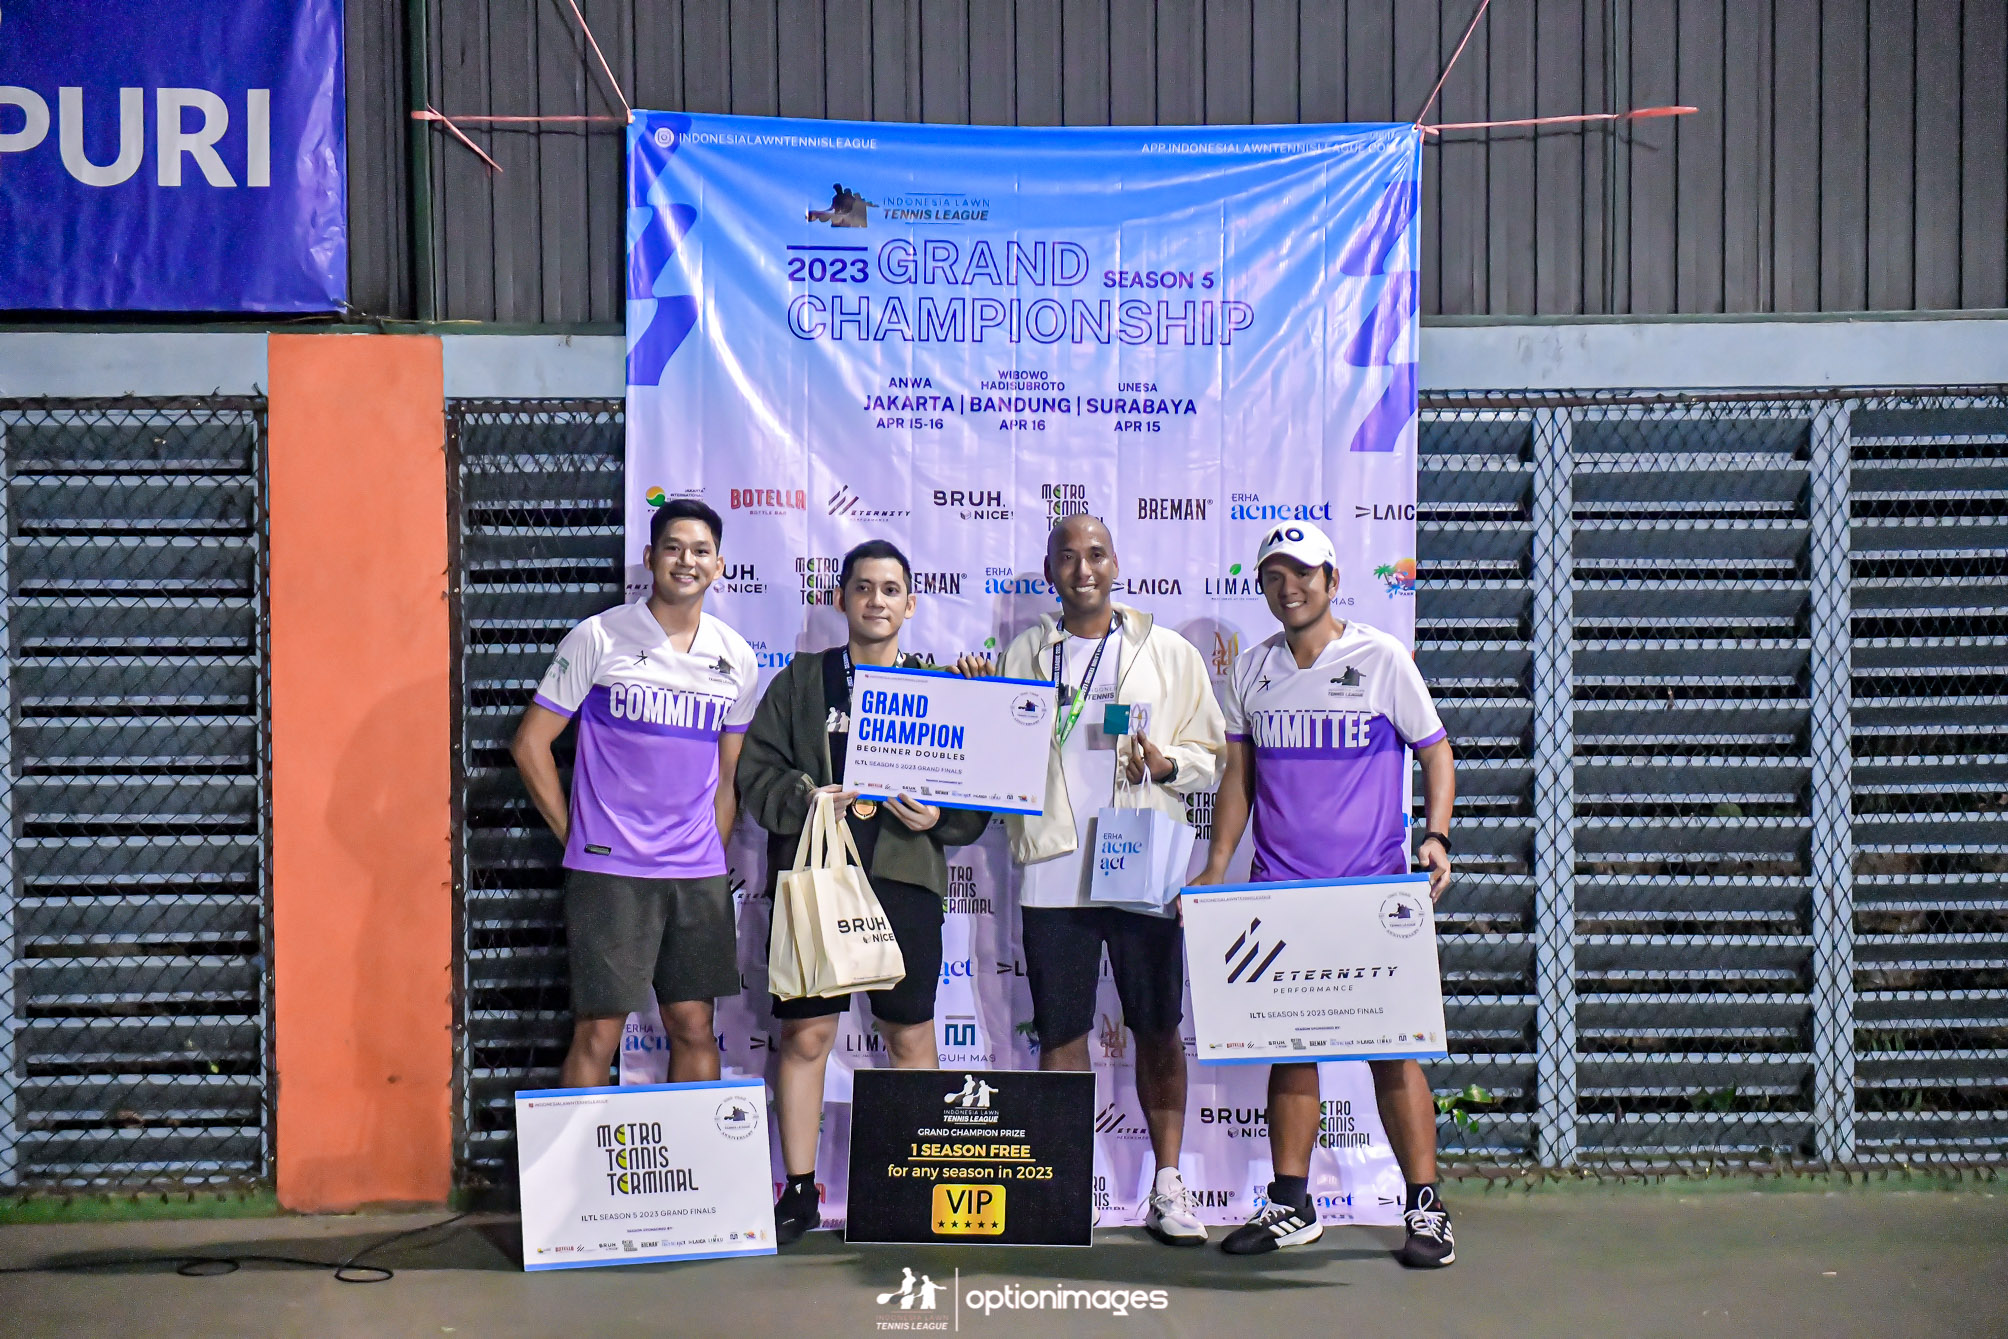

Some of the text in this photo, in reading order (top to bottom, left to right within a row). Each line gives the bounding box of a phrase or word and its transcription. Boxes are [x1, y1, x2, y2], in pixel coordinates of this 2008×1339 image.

[679, 132, 877, 150] INDONESIALAWNTENNISLEAGUE
[955, 198, 990, 208] LAWN
[883, 208, 989, 222] TENNIS LEAGUE
[787, 238, 1214, 290] 2023 GRAND SEASON 5
[787, 294, 1254, 346] CHAMPIONSHIP
[998, 370, 1048, 380] WIBOWO
[888, 377, 932, 389] ANWA
[981, 381, 1065, 392] HADISUBROTO
[1118, 382, 1158, 393] UNESA
[863, 395, 1197, 415] JAKARTA BANDUNG SURABAYA
[876, 418, 944, 430] APR 15-16
[999, 419, 1046, 431] APR 16
[1114, 421, 1161, 432] APR 15
[730, 488, 807, 510] BOTELLA
[1041, 484, 1086, 499] METRO
[1046, 500, 1089, 515] TENNIS
[1231, 502, 1333, 520] acne act
[795, 557, 839, 573] METRO
[985, 567, 1014, 576] ERHA
[728, 583, 767, 594] NICE!
[985, 577, 1045, 594] acne
[1127, 579, 1182, 594] LAICA
[861, 689, 928, 718] GRAND
[1087, 692, 1115, 701] TENNIS
[858, 717, 965, 750] CHAMPION
[1252, 709, 1371, 748] OMMITTEE
[856, 744, 965, 761] BEGINNER DOUBLES
[1103, 832, 1123, 840] ERHA
[1101, 842, 1143, 854] acne
[950, 866, 973, 881] TRO
[950, 882, 977, 898] NNIS
[1273, 966, 1399, 982] ETERNITY
[1273, 984, 1354, 994] PERFORMANCE
[1327, 1008, 1356, 1016] GRAND
[1357, 1007, 1384, 1015] FINALS
[626, 1024, 654, 1033] ERHA
[846, 1034, 883, 1051] LIM
[938, 1053, 996, 1062] GUH MAS
[1320, 1101, 1351, 1115] ETRO
[943, 1115, 998, 1123] TENNIS LEAGUE
[1320, 1117, 1355, 1132] ENNIS
[597, 1122, 662, 1147] METRO
[917, 1128, 1025, 1138] GRAND CHAMPION PRIZE
[1241, 1127, 1269, 1138] NIC
[911, 1143, 1031, 1158] 1 SEASON FREE
[605, 1146, 669, 1171] TENNIS
[888, 1165, 1053, 1180] for any season in 2023
[607, 1168, 699, 1196] TERMINAL
[946, 1189, 993, 1214] VIP
[581, 1214, 598, 1222] ILTL
[600, 1212, 631, 1220] SEASON
[661, 1209, 689, 1217] GRAND
[690, 1207, 716, 1215] FINALS
